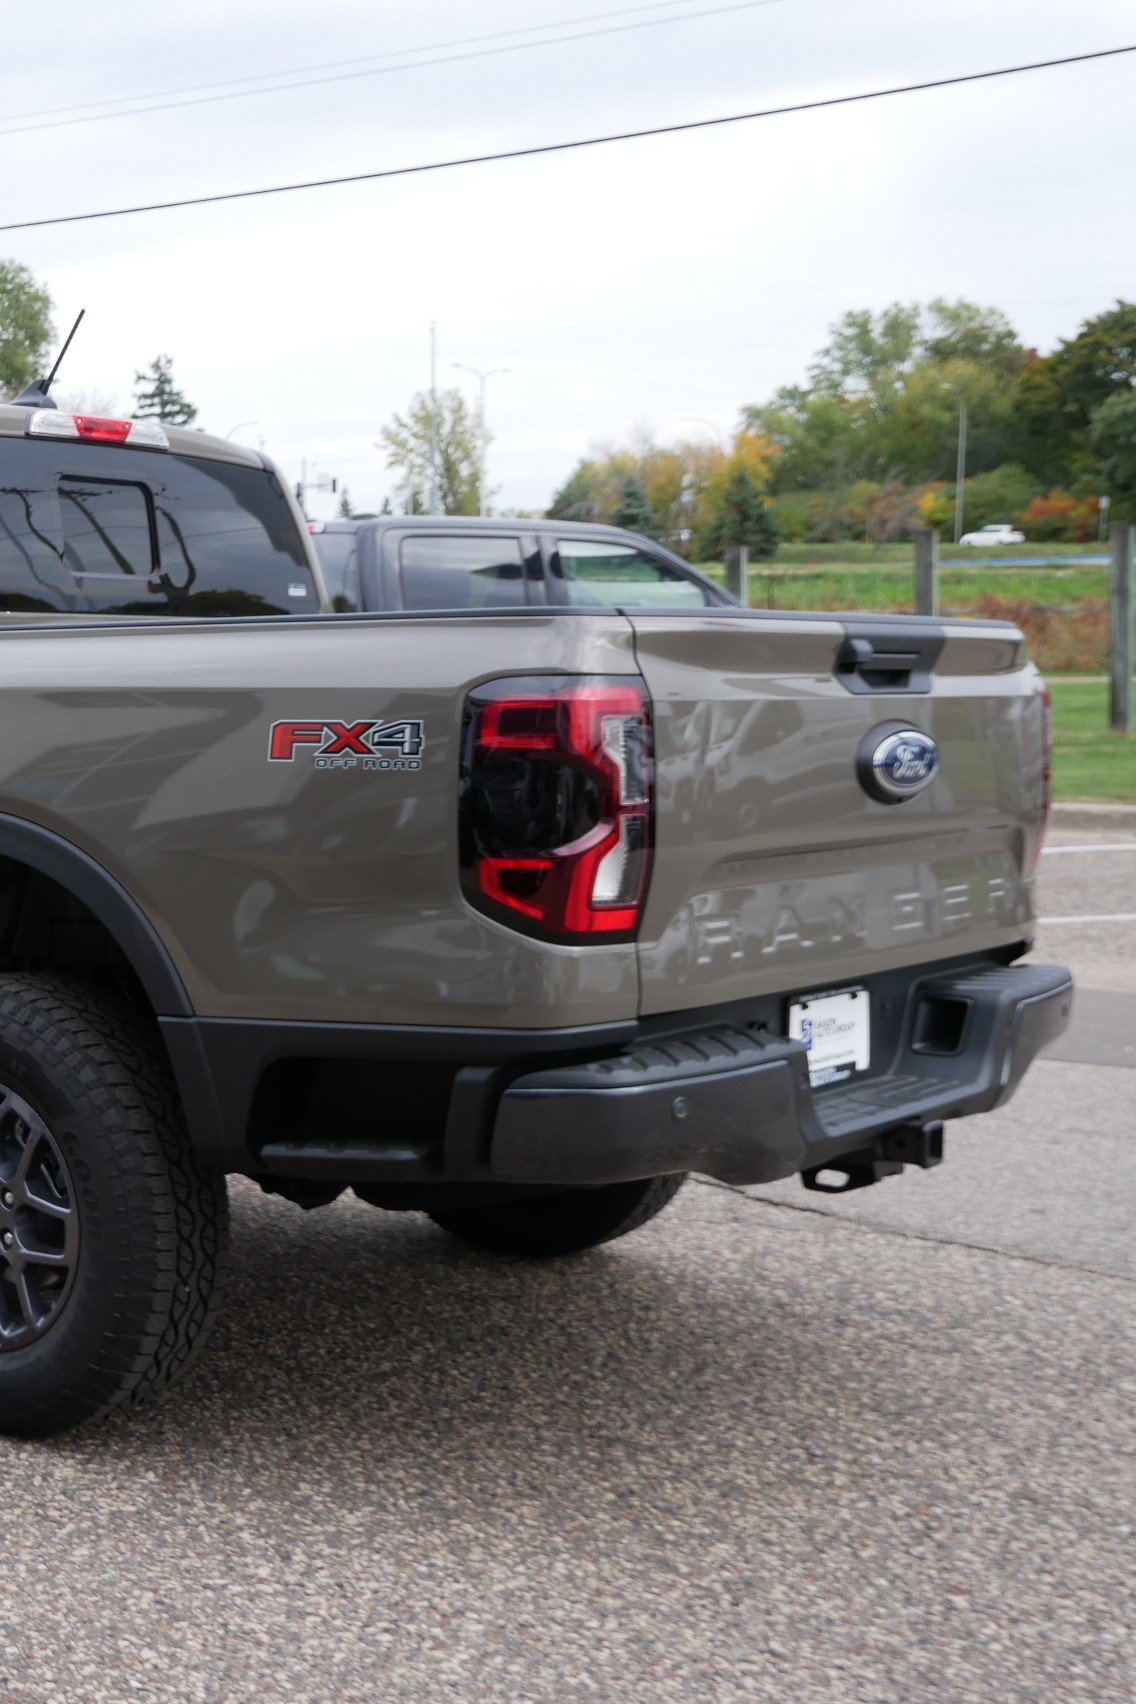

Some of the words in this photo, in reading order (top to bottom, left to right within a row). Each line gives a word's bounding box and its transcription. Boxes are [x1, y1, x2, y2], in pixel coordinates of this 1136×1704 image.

[268, 720, 425, 762] FX4
[315, 757, 358, 770] OFF
[364, 758, 422, 771] ROAD
[893, 745, 931, 778] Ford
